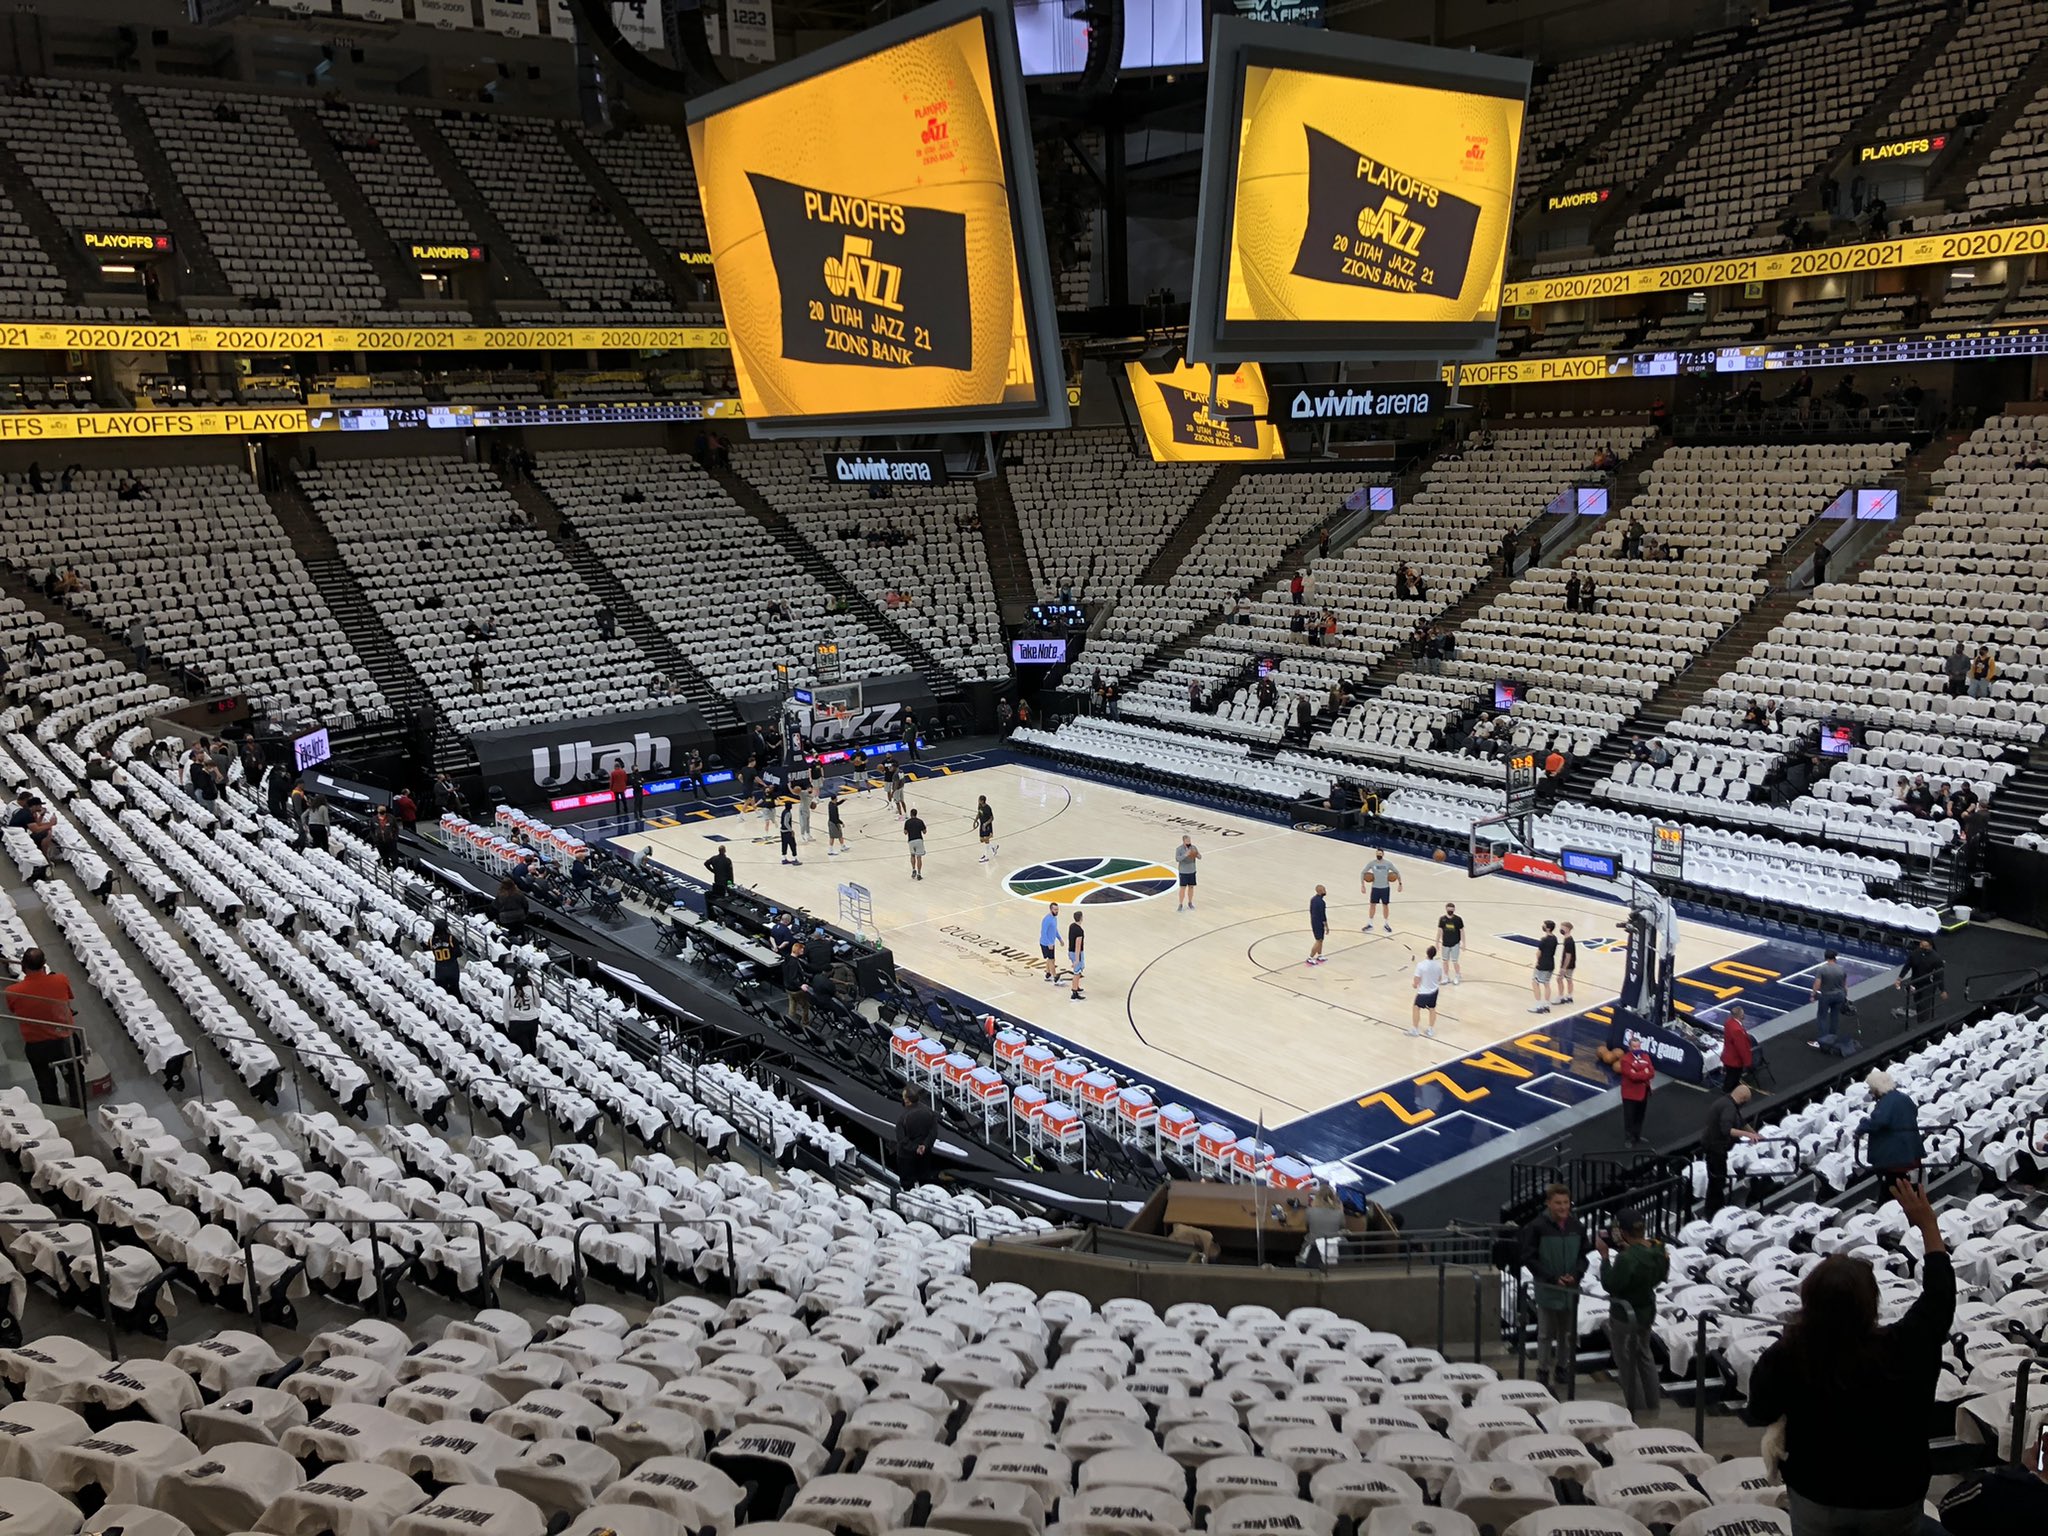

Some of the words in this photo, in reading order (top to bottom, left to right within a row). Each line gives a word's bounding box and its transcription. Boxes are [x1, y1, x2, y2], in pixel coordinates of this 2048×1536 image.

[733, 9, 766, 26] 1223
[1861, 138, 1930, 162] PLAYOFFS
[1357, 156, 1440, 208] PLAYOFFS
[1549, 190, 1598, 210] PLAYOFFS
[804, 191, 906, 236] PLAYOFFS
[1357, 195, 1426, 257] JAZZ
[84, 234, 154, 248] PLAYOFFS
[412, 246, 469, 259] PLAYOFFS
[1332, 234, 1348, 253] 20
[1354, 240, 1383, 263] UTAH
[1388, 252, 1416, 277] JAZZ
[1421, 267, 1434, 285] 21
[823, 234, 904, 312] JAZZ
[1341, 257, 1381, 284] ZIONS
[1382, 270, 1416, 293] BANK
[1544, 275, 1630, 299] 2020/2021
[1659, 261, 1757, 288] 2020/2021
[1790, 244, 1903, 275] 2020/2021
[809, 301, 824, 323] 20
[831, 305, 863, 329] UTAH
[870, 313, 906, 342] JAZZ
[914, 327, 932, 351] 21
[66, 329, 180, 348] 2020/2021
[216, 331, 323, 348] 2020/2021
[357, 331, 455, 348] 2020/2021
[484, 331, 574, 347] 2020/2021
[601, 331, 685, 346] 2020/2021
[824, 327, 869, 357] ZIONS
[872, 338, 913, 366] BANK
[1722, 348, 1741, 357] UTA
[1654, 353, 1675, 361] MEM
[1679, 351, 1715, 364] 77:19
[1541, 357, 1606, 379] PLAYOF
[1314, 389, 1373, 417] vivint
[1375, 393, 1429, 415] arena
[388, 409, 426, 421] 77:19
[76, 414, 194, 434] PLAYOFFS
[225, 413, 307, 430] PLAYOF
[1186, 424, 1194, 432] 20
[1197, 425, 1212, 435] UTAH
[1215, 430, 1231, 441] JAZZ
[1234, 434, 1242, 444] 21
[1194, 432, 1214, 445] ZIONS
[1215, 436, 1234, 447] BANK
[849, 457, 891, 480] vivint
[890, 462, 931, 481] arena
[1019, 643, 1038, 660] Take
[531, 732, 672, 788] Utah
[939, 924, 1000, 949] arena
[434, 948, 451, 962] 00
[513, 999, 531, 1012] 45
[896, 1038, 903, 1050] G
[1000, 1042, 1007, 1053] G
[920, 1051, 926, 1062] G
[1657, 1040, 1685, 1064] game
[949, 1065, 955, 1076] G
[1028, 1059, 1035, 1069] G
[1060, 1072, 1067, 1084] G
[1356, 1033, 1574, 1127] JAZZ
[974, 1081, 980, 1092] G
[1088, 1086, 1096, 1097] G
[1018, 1100, 1024, 1112] G
[1124, 1102, 1131, 1113] G
[1047, 1116, 1054, 1128] G
[1165, 1119, 1173, 1131] G
[1205, 1138, 1213, 1150] G
[1242, 1153, 1251, 1166] G
[1278, 1174, 1288, 1187] G
